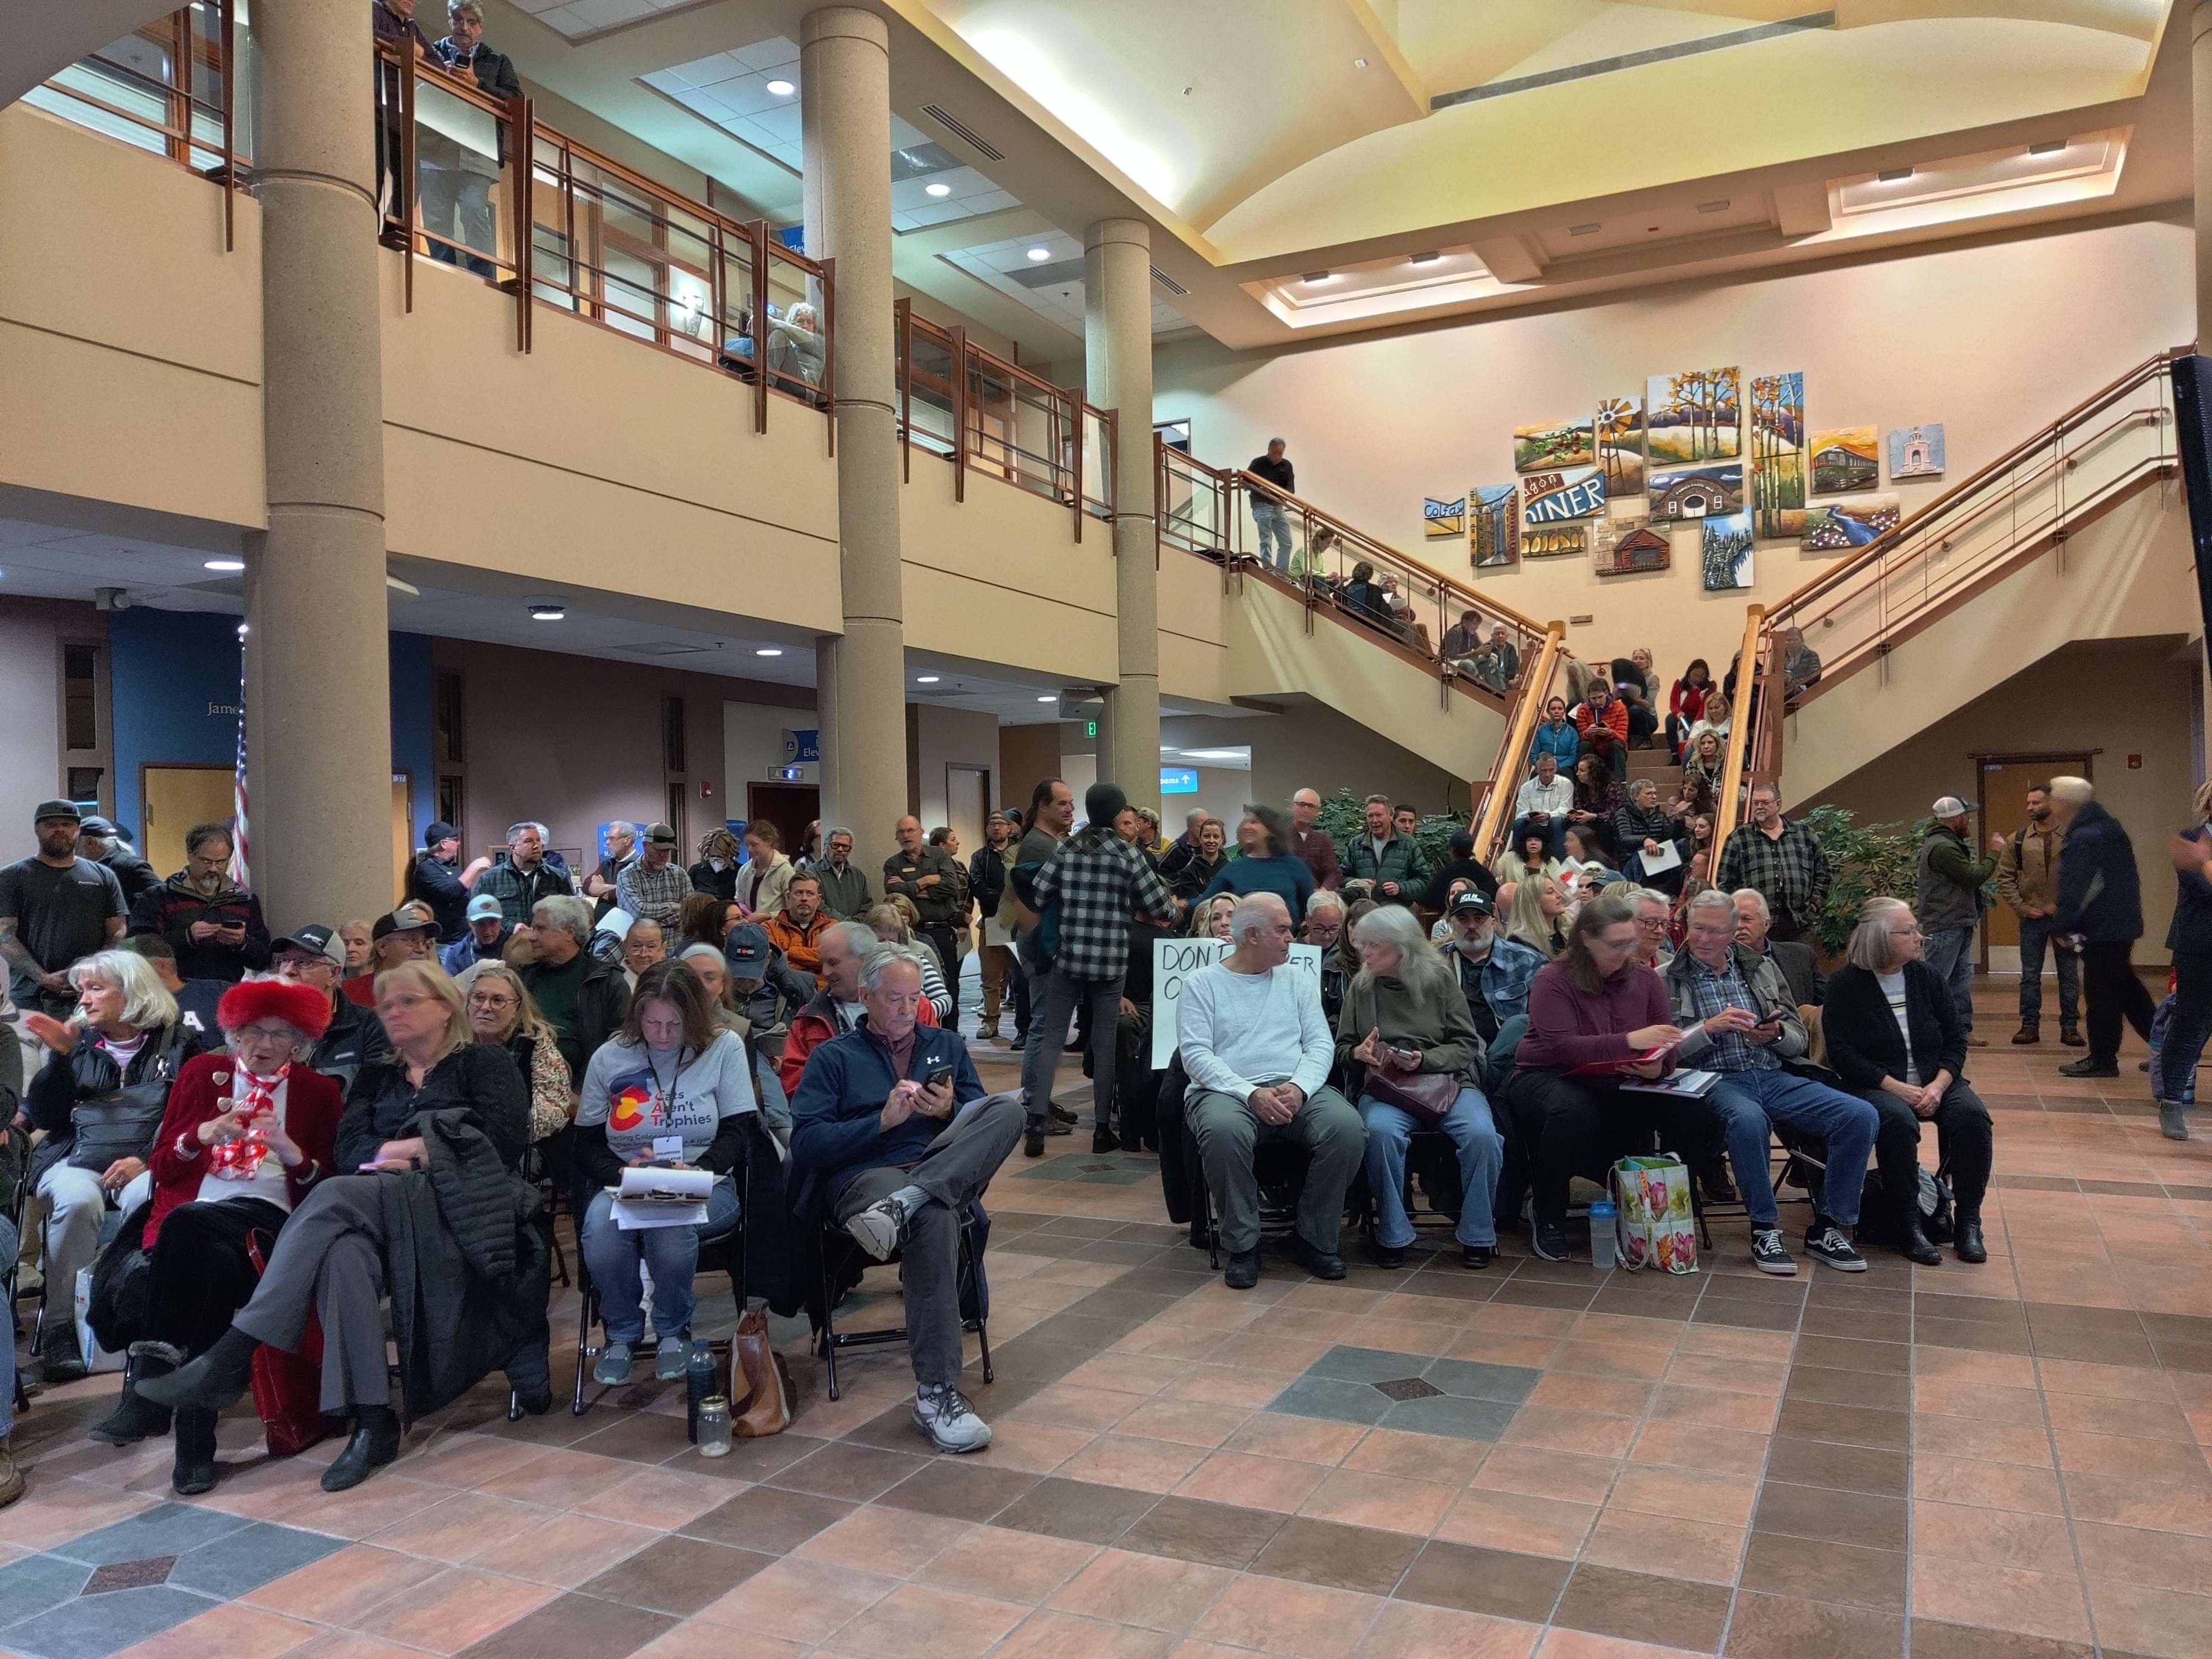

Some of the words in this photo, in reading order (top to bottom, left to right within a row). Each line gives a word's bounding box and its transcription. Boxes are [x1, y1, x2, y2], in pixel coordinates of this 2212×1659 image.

[1425, 504, 1464, 517] Colfax
[1163, 942, 1233, 972] DON'T
[651, 1101, 695, 1113] Aen't
[650, 1114, 712, 1129] Trophies
